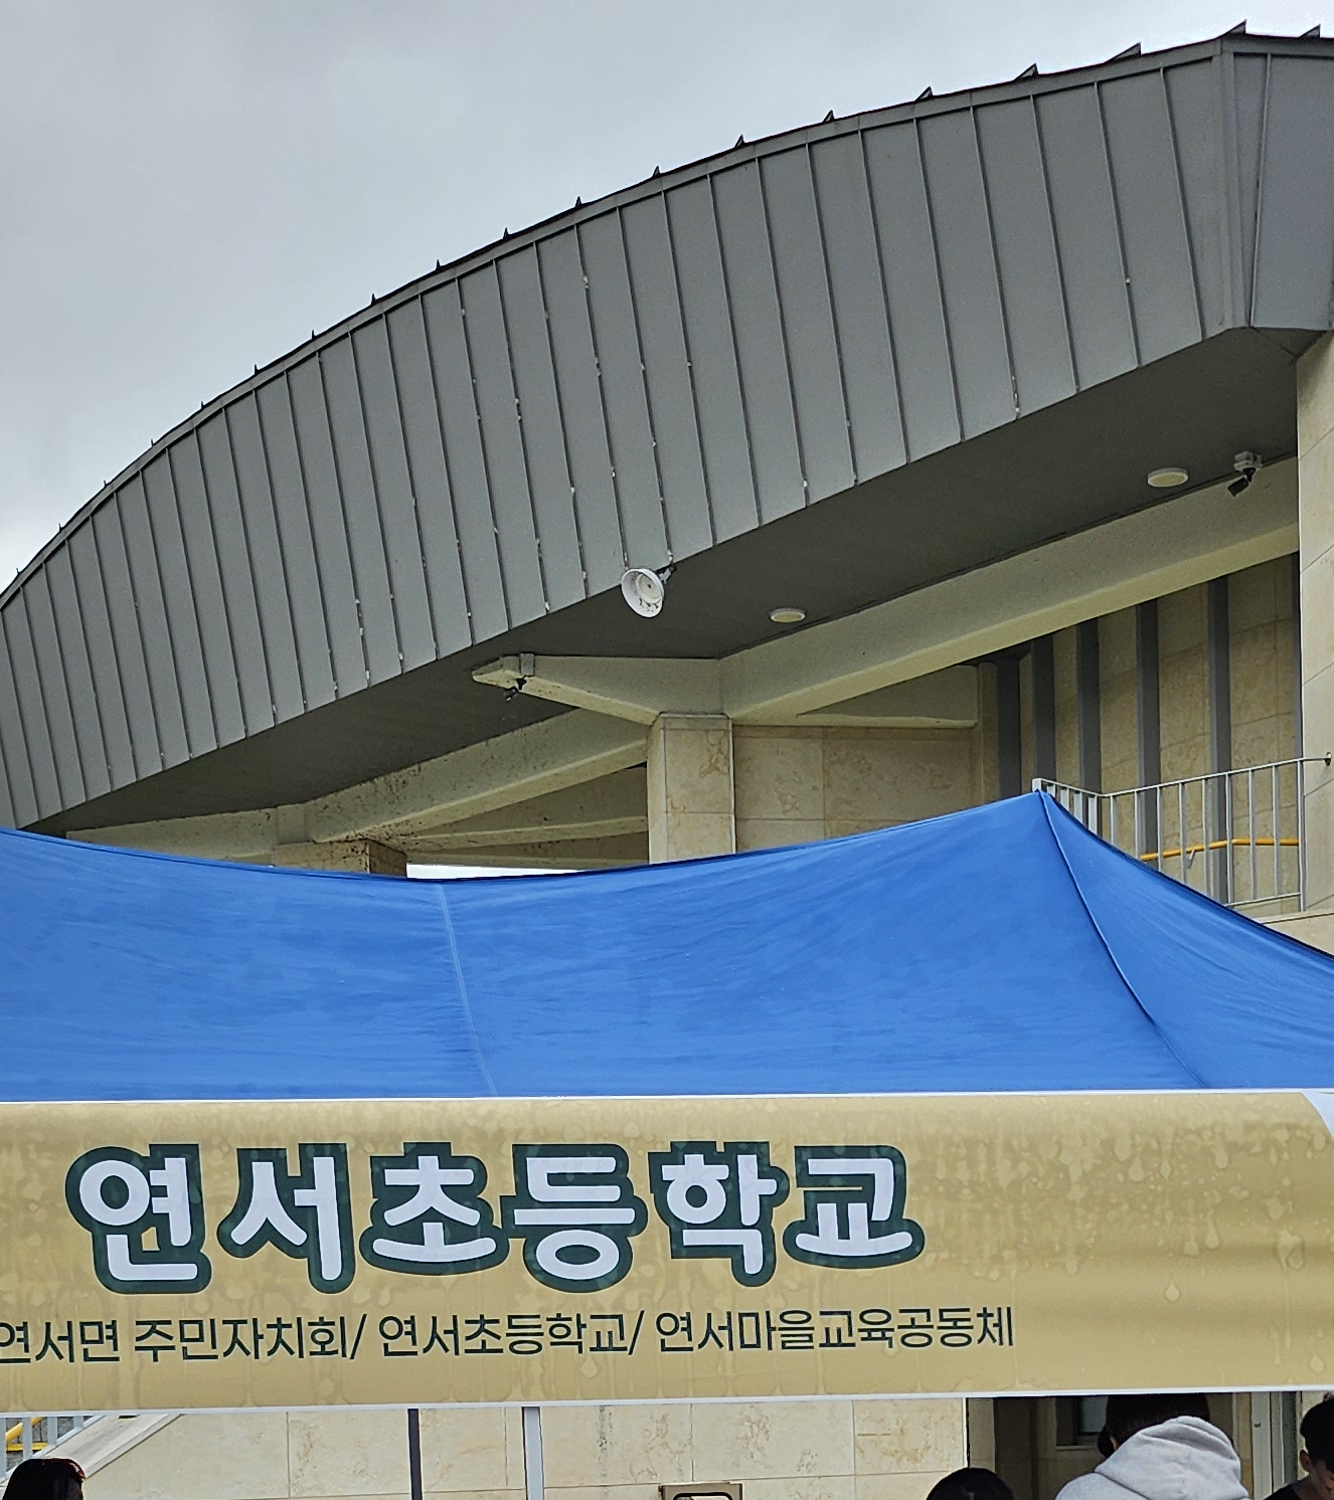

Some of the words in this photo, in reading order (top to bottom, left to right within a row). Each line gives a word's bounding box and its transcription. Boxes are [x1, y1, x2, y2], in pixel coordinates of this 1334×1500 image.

[67, 1141, 924, 1293] 연서초등학교
[133, 1313, 368, 1363] 주민자치회/
[378, 1309, 646, 1358] 연서초등학교/
[655, 1306, 1014, 1353] 연서마을교육공동체
